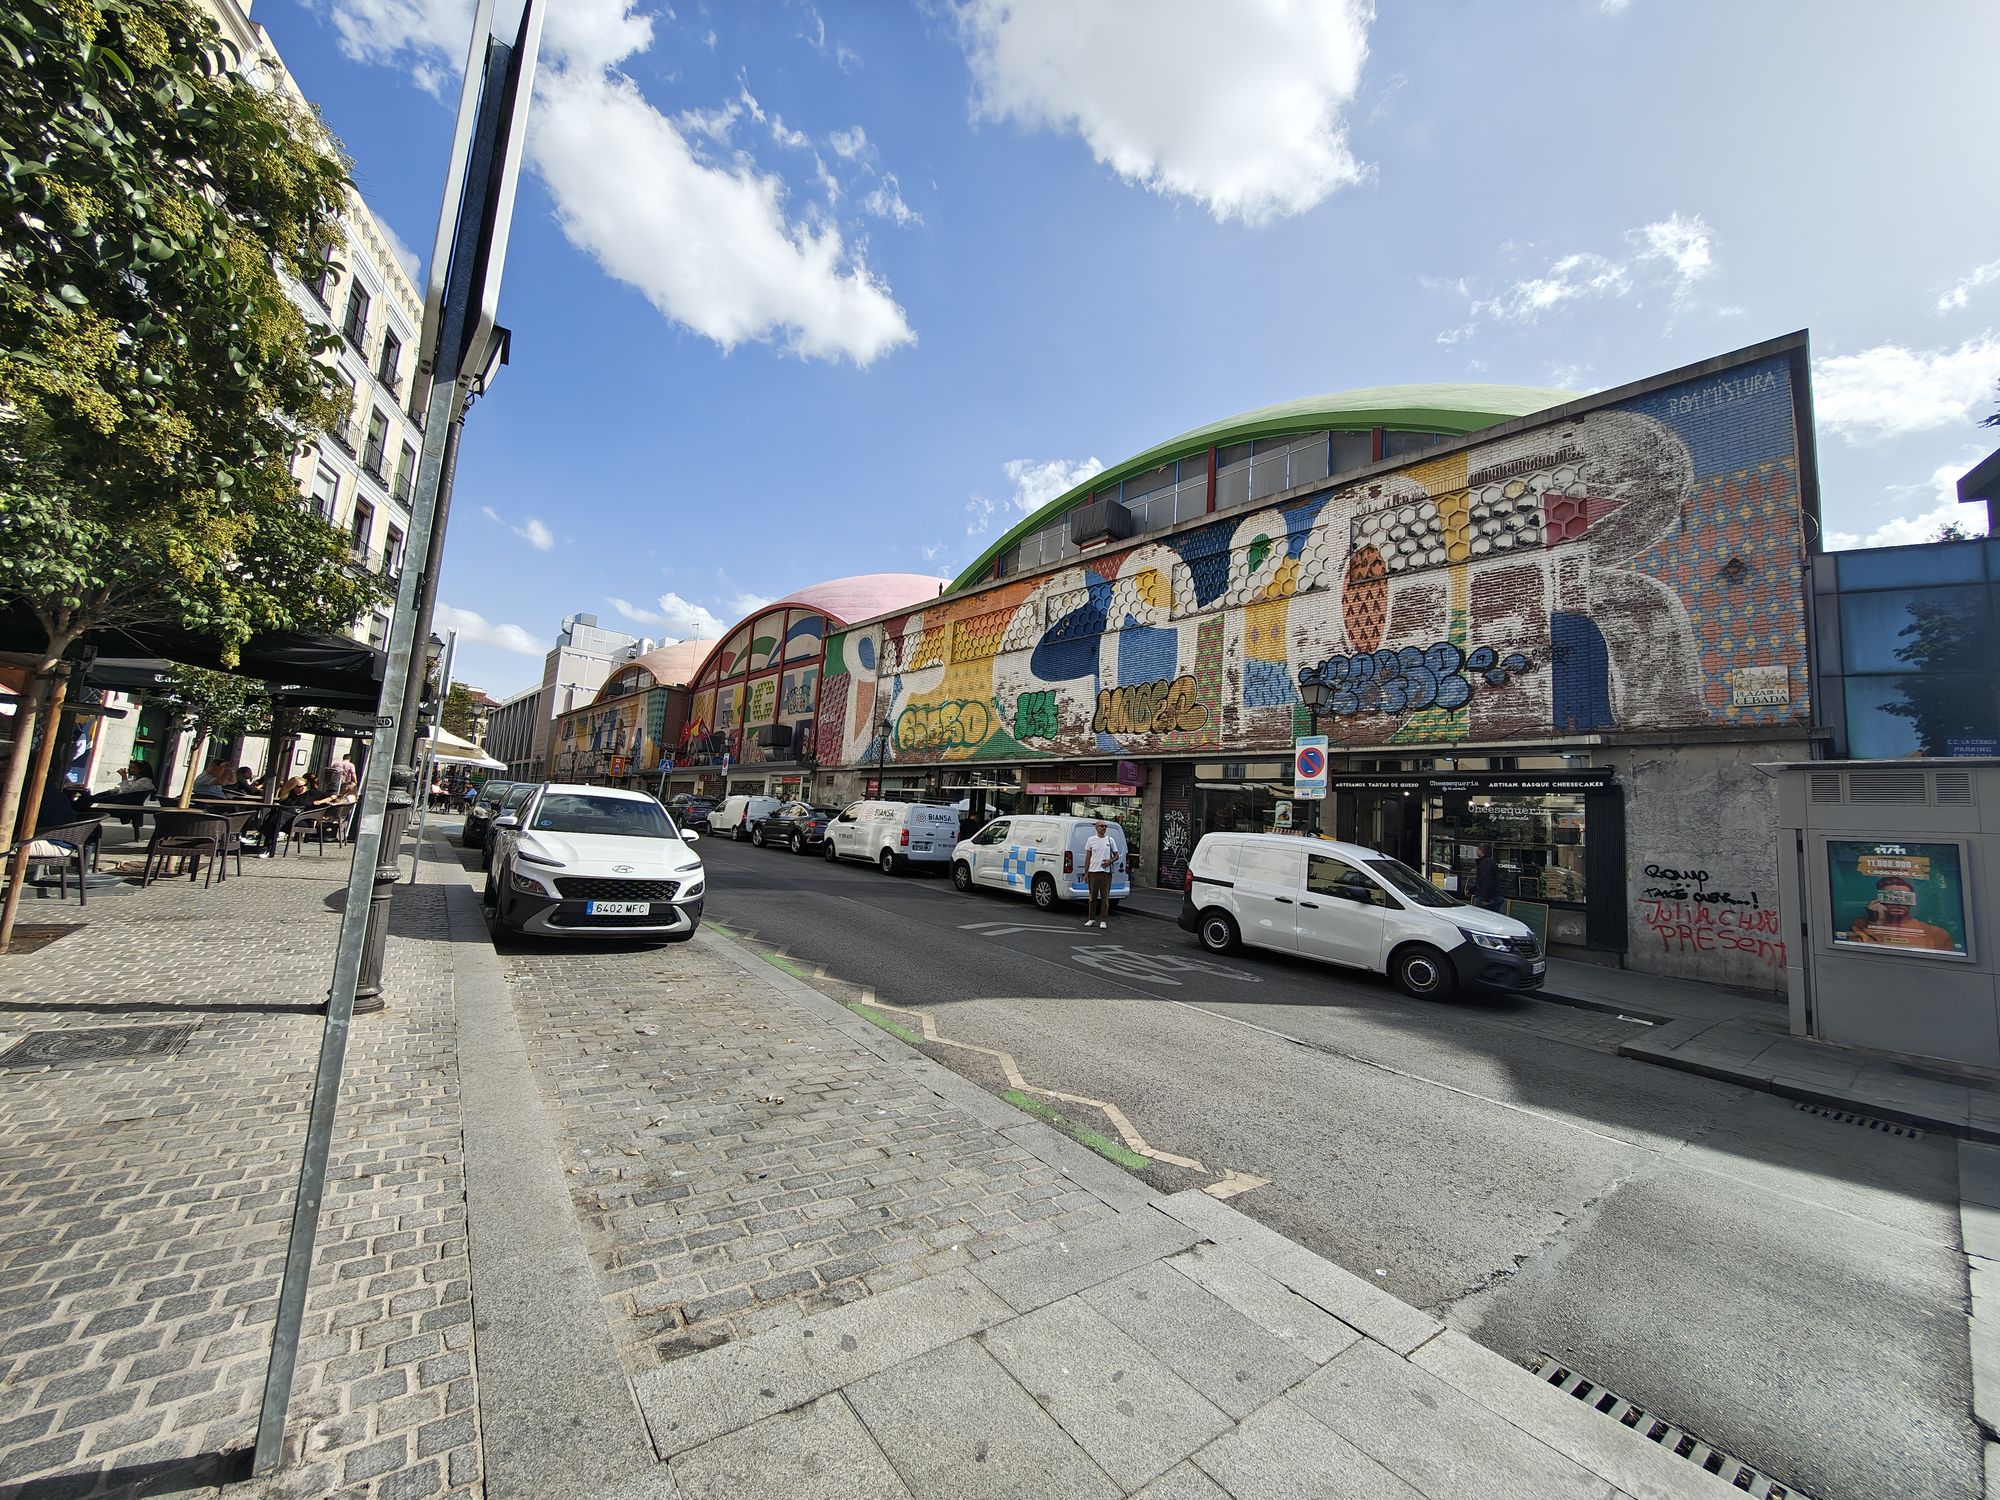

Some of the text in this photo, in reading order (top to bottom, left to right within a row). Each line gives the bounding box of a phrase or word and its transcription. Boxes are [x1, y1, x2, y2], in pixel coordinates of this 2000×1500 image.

[1736, 690, 1766, 698] PLAZA
[1735, 695, 1788, 705] CEBADA
[874, 808, 895, 818] BIANSA
[1468, 803, 1550, 816] Cheesequeria
[928, 813, 952, 822] BIANSA
[596, 903, 645, 913] 6402 MFC
